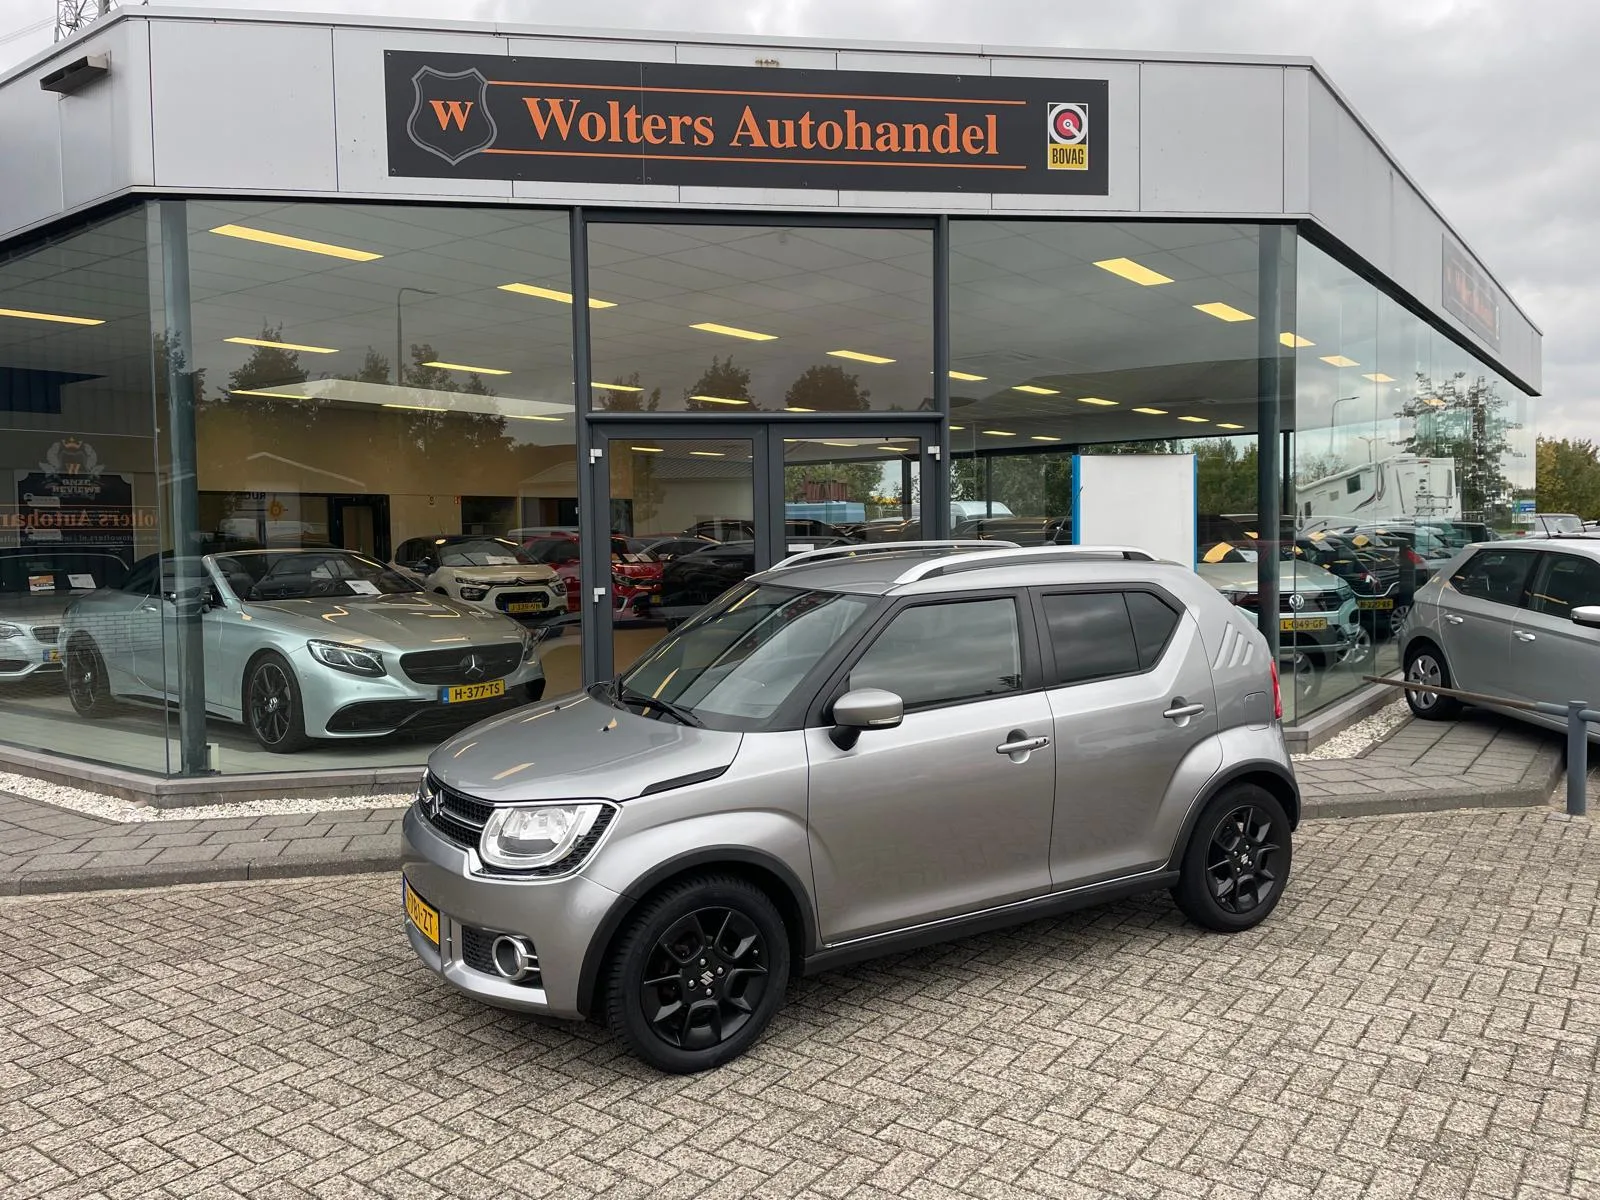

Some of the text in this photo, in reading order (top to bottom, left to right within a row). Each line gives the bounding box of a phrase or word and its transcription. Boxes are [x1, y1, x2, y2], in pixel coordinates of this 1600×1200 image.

[429, 100, 474, 132] W
[522, 97, 999, 155] Wolters Autohandel
[1051, 147, 1085, 166] BOVAG
[454, 683, 500, 700] H-377-TS
